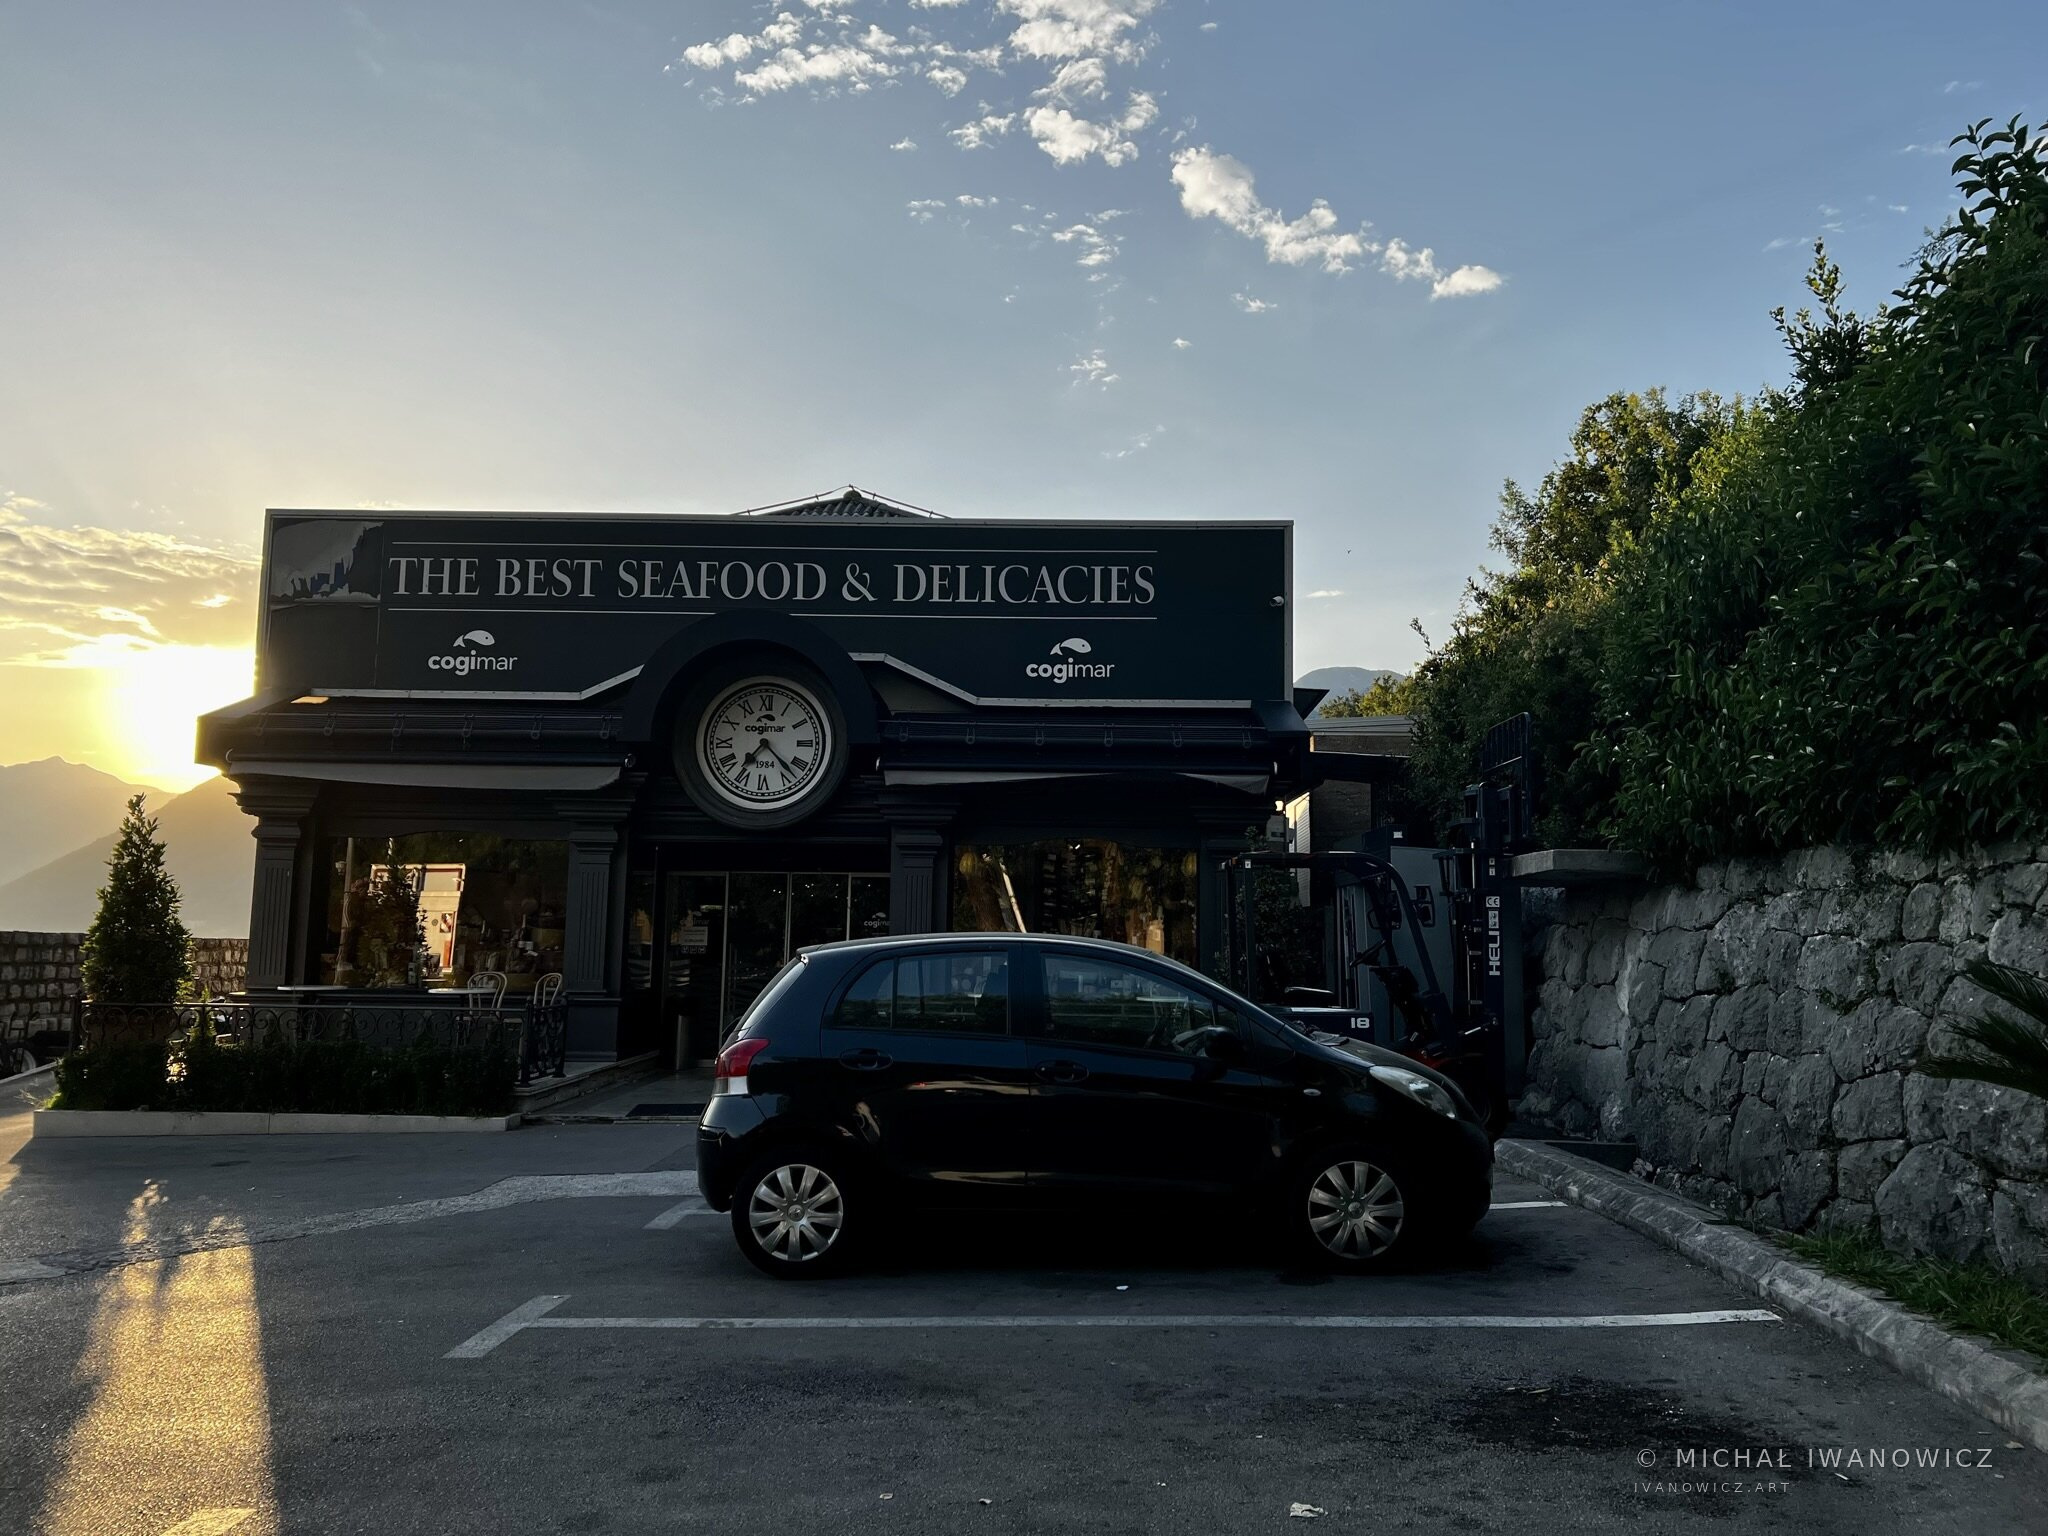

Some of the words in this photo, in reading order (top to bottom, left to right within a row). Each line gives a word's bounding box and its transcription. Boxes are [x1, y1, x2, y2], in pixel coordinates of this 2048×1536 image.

[388, 557, 480, 596] THE
[494, 558, 603, 597] BEST
[618, 559, 827, 600] SEAFOOD
[841, 563, 878, 602] &
[892, 564, 1155, 604] DELICACIES
[427, 650, 518, 676] cogimar
[1026, 657, 1115, 684] cogimar
[737, 699, 755, 718] XI
[759, 695, 774, 711] XII
[722, 715, 740, 731] X
[744, 723, 786, 735] cogimar
[792, 718, 809, 730] II
[796, 739, 814, 748] III
[755, 761, 775, 769] 1984
[757, 774, 770, 791] VI
[780, 771, 792, 787] V
[1488, 930, 1501, 976] HELI
[1350, 1017, 1370, 1029] 18
